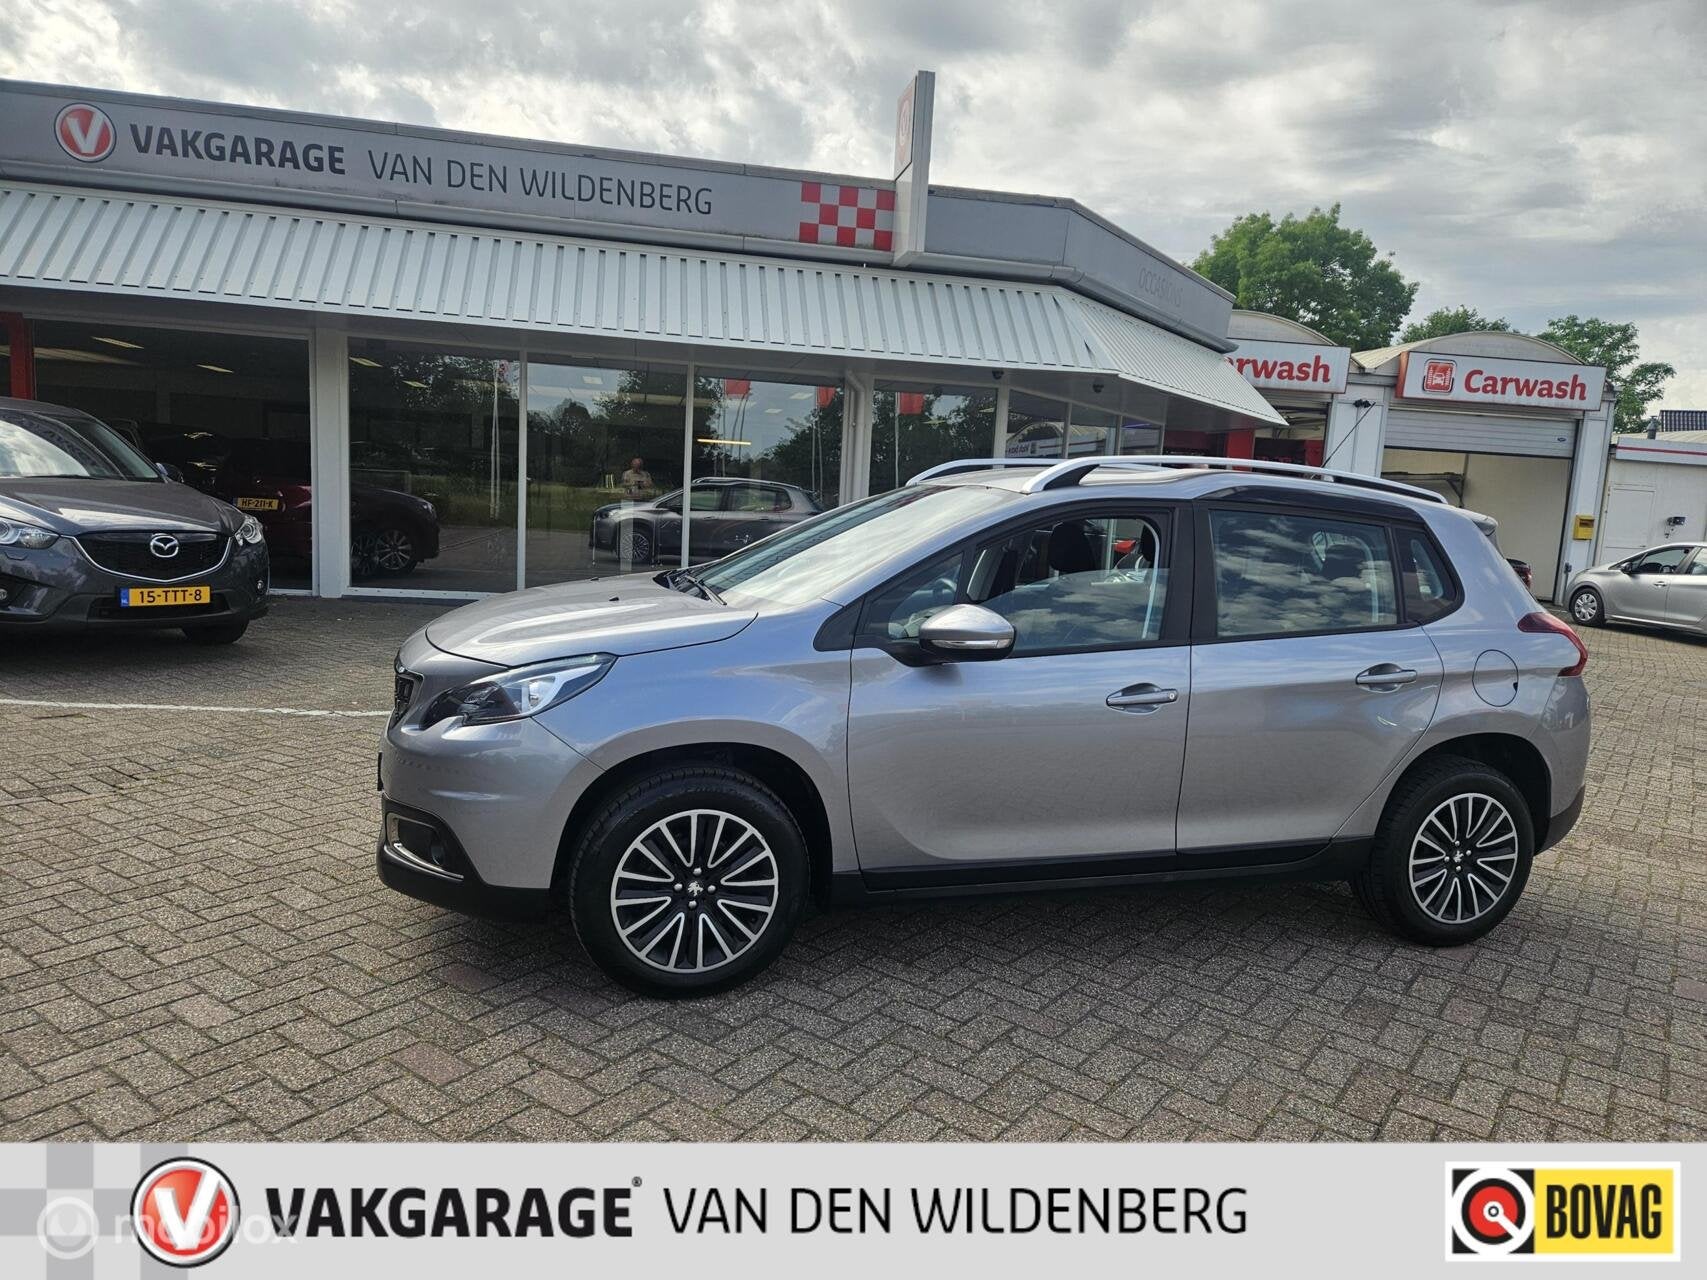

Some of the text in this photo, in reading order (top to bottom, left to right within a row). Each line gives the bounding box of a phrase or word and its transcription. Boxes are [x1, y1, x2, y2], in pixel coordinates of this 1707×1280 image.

[129, 123, 712, 215] VAKGARAGE VAN DEN WILDENBERG
[1226, 354, 1331, 383] rwash
[1464, 369, 1587, 401] Carwash
[139, 588, 202, 604] 15-TTT-8
